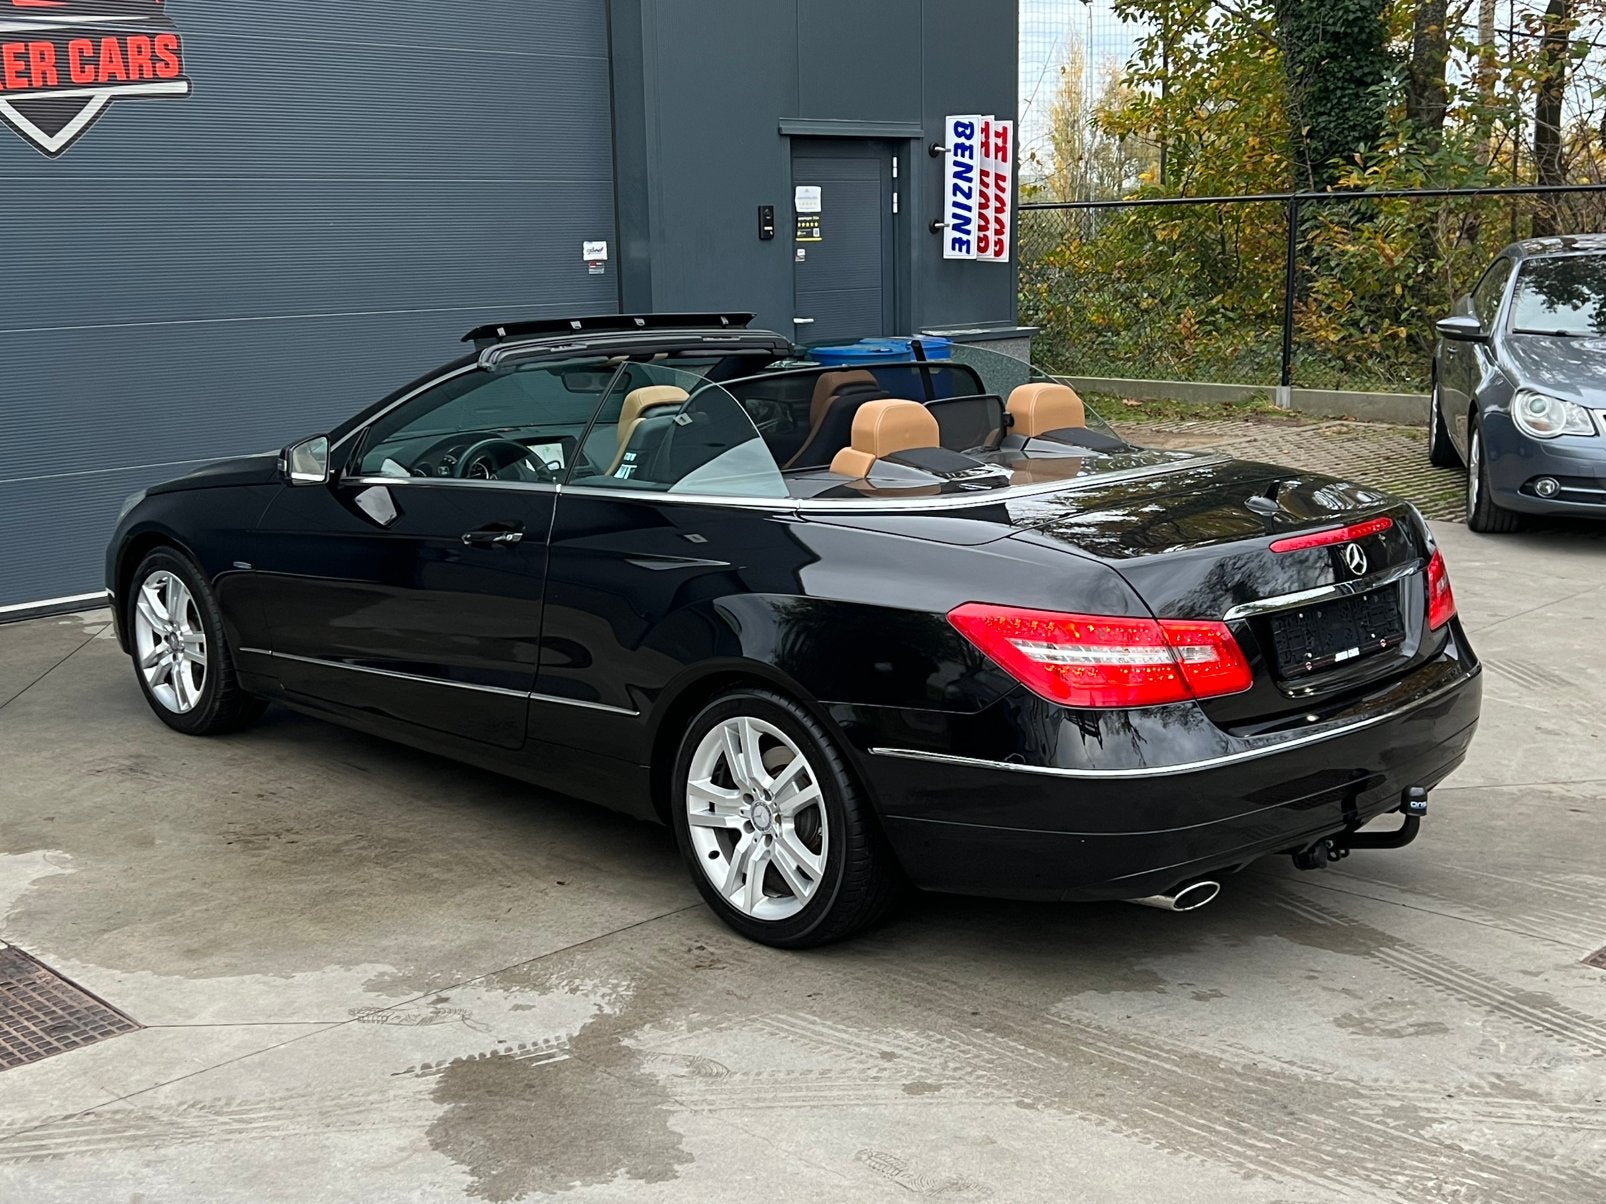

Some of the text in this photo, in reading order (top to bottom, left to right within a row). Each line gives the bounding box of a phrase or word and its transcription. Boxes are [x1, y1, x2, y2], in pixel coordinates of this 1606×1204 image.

[0, 33, 180, 91] ER CARS
[951, 121, 975, 255] BENZINE
